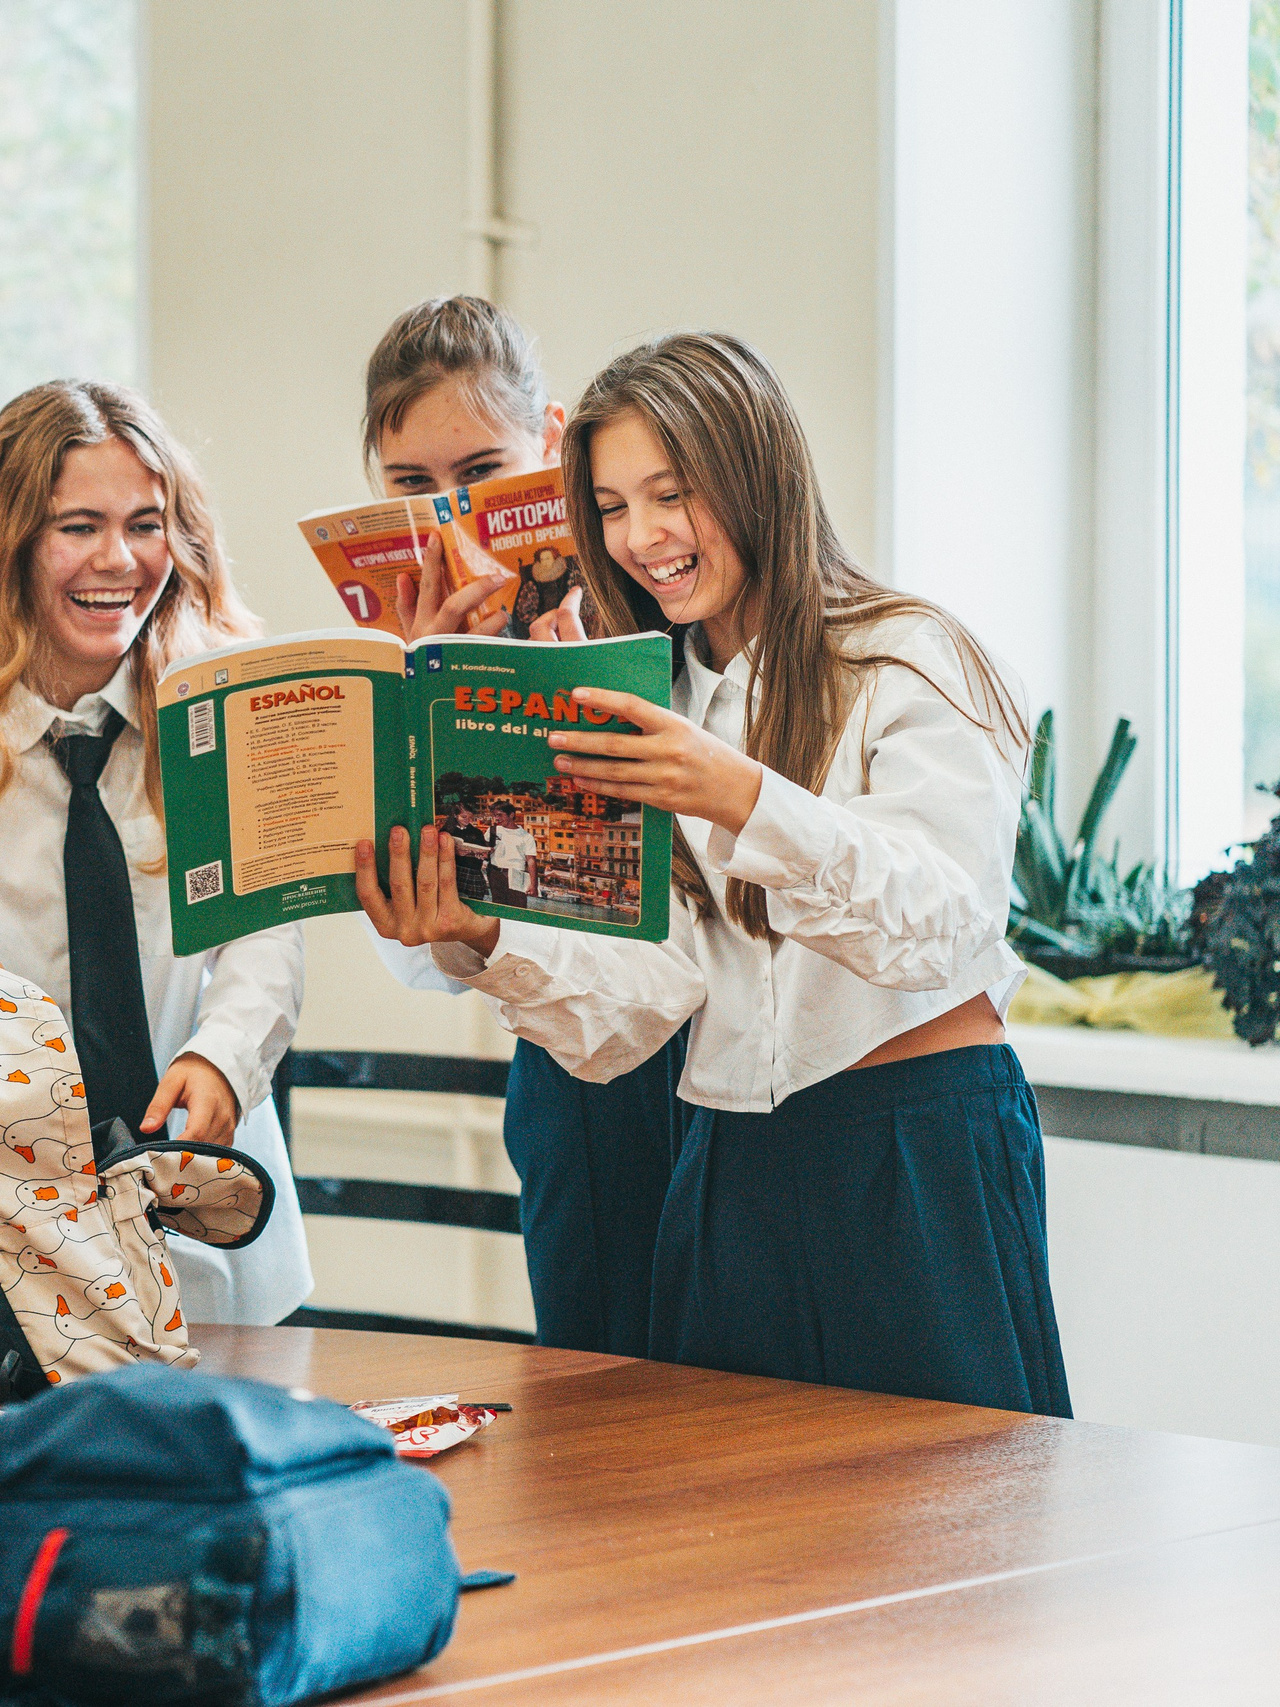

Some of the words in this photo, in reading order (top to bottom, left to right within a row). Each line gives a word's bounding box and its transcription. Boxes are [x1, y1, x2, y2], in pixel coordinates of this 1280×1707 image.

[491, 530, 533, 552] НОВОГО
[344, 585, 369, 619] 7
[462, 664, 516, 674] Kondrashova
[250, 683, 346, 712] ESPAÑOL
[455, 719, 496, 732] libro
[501, 722, 528, 736] del
[282, 898, 327, 912] www.prosv.ru
